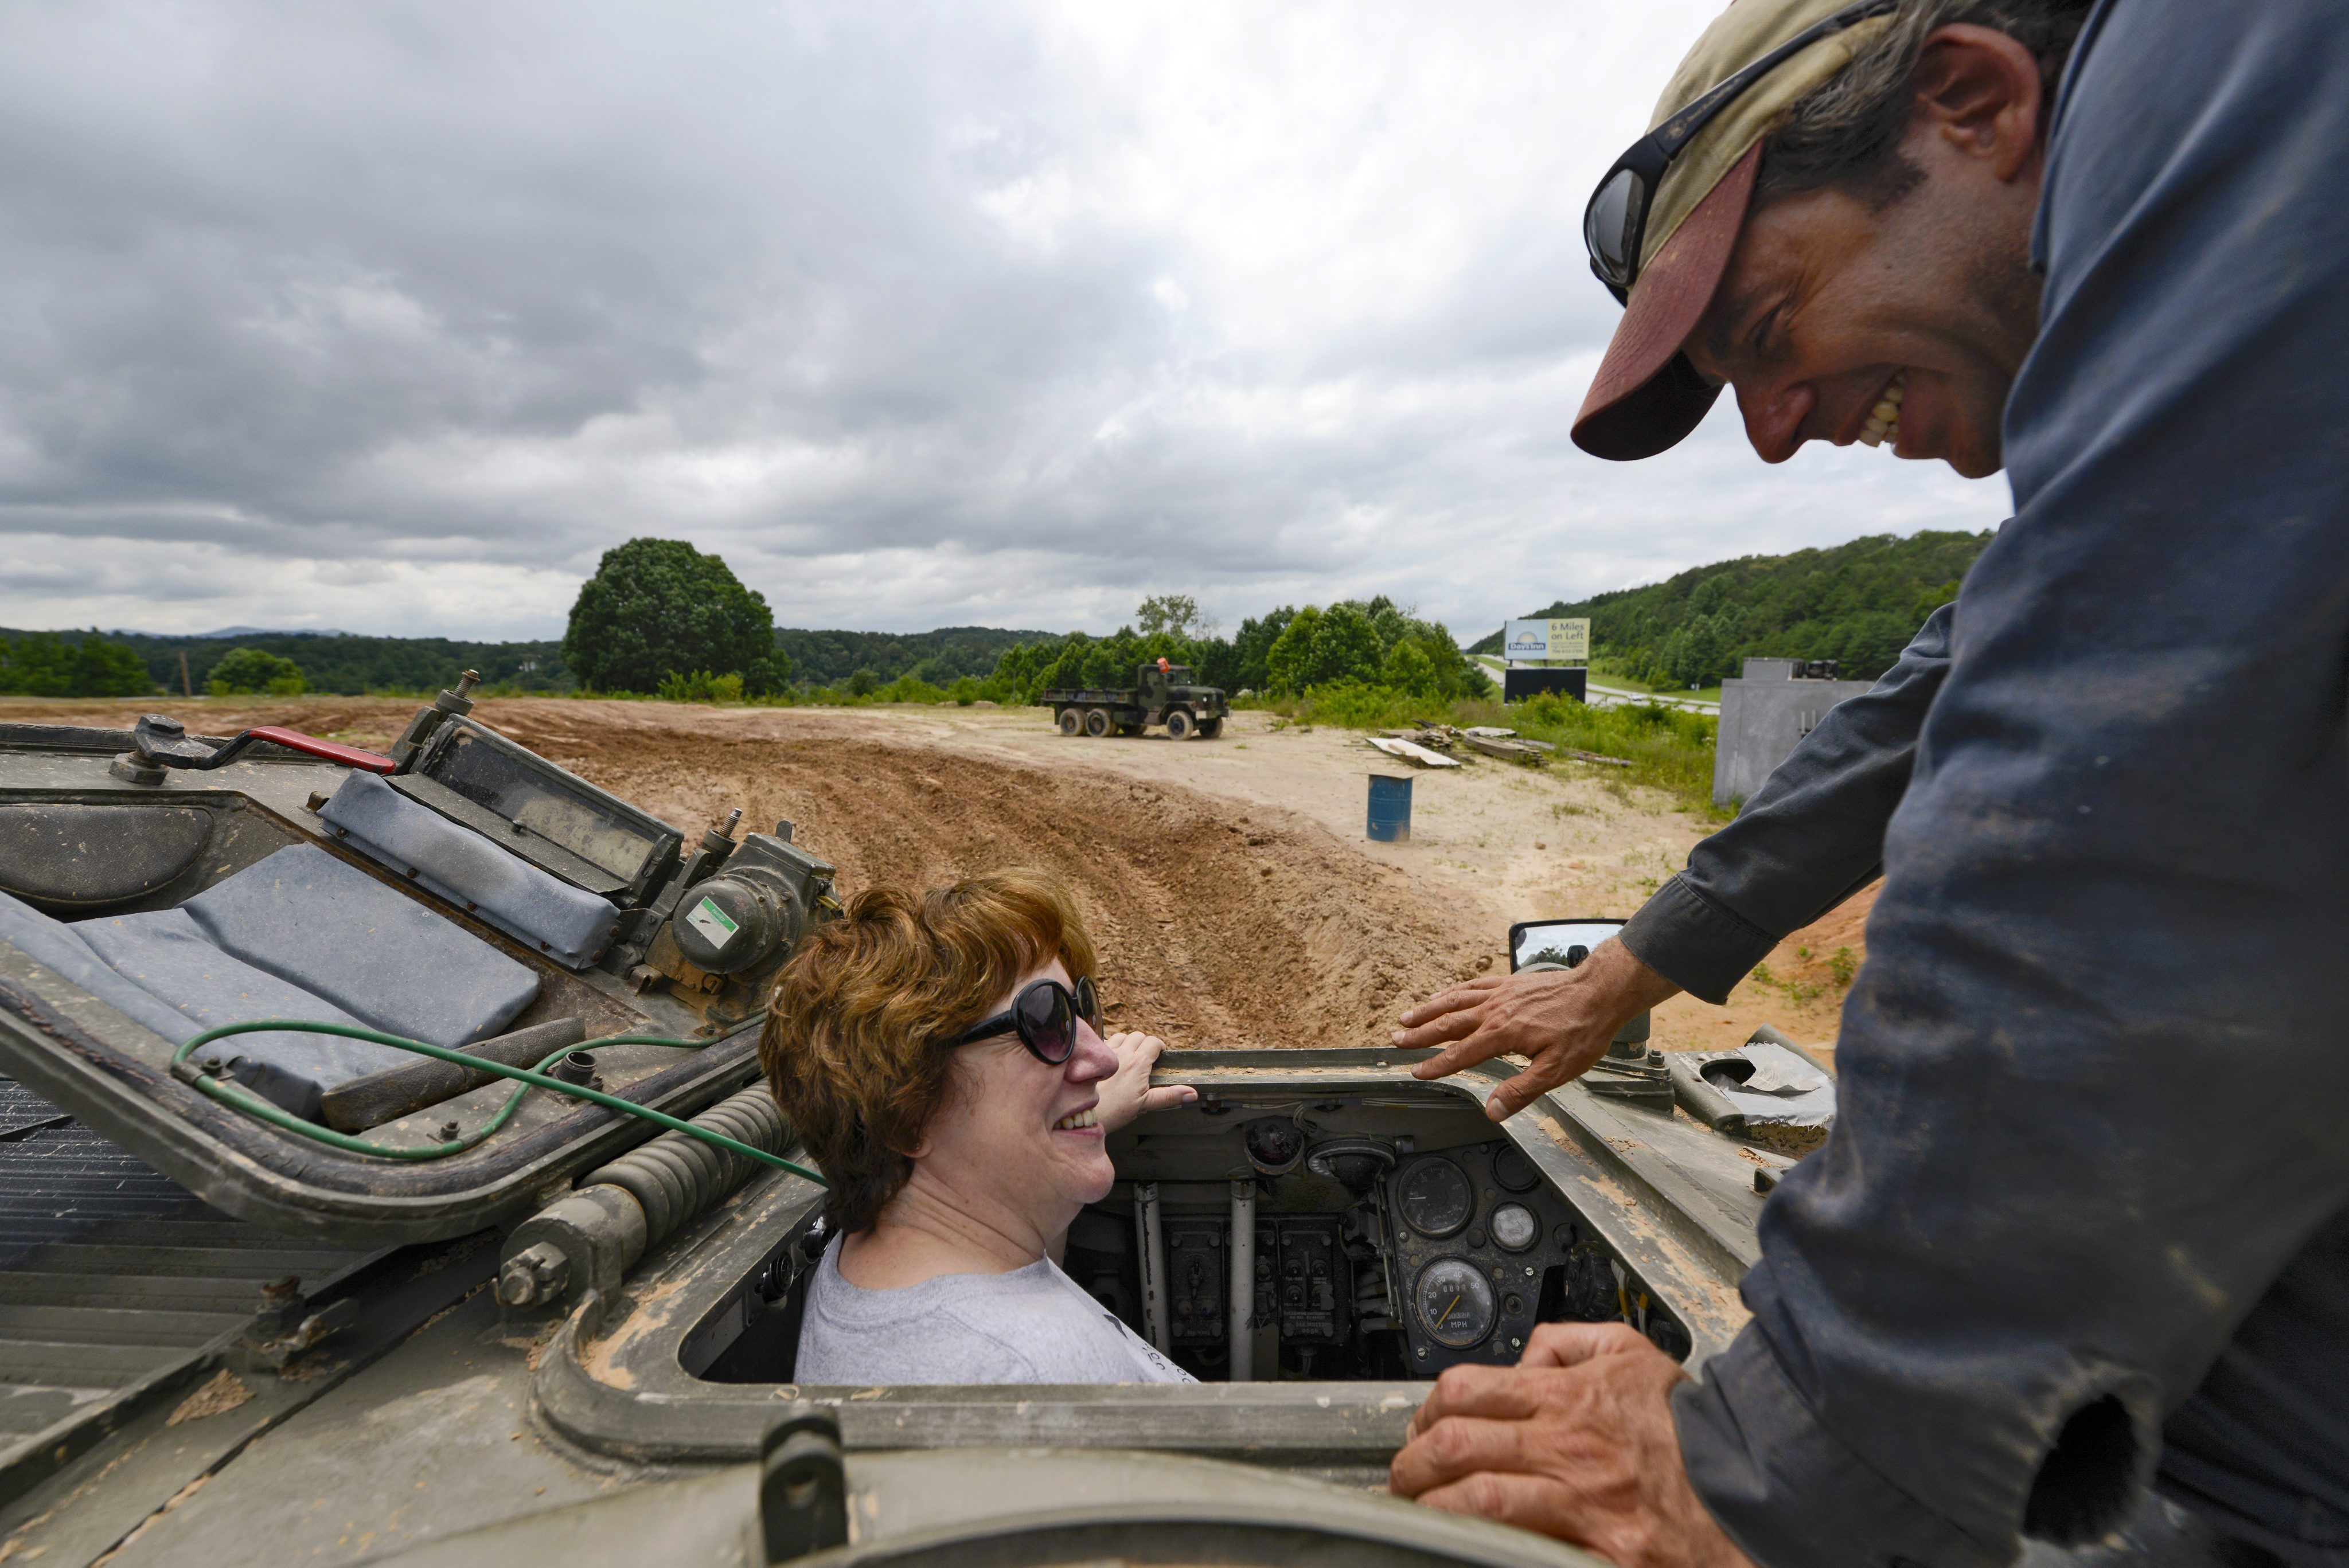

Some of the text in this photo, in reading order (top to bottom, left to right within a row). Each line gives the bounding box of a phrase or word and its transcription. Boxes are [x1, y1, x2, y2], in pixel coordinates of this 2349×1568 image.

[1552, 622, 1585, 631] 6 Miles
[1566, 631, 1583, 640] Left
[712, 909, 725, 922] PASSED
